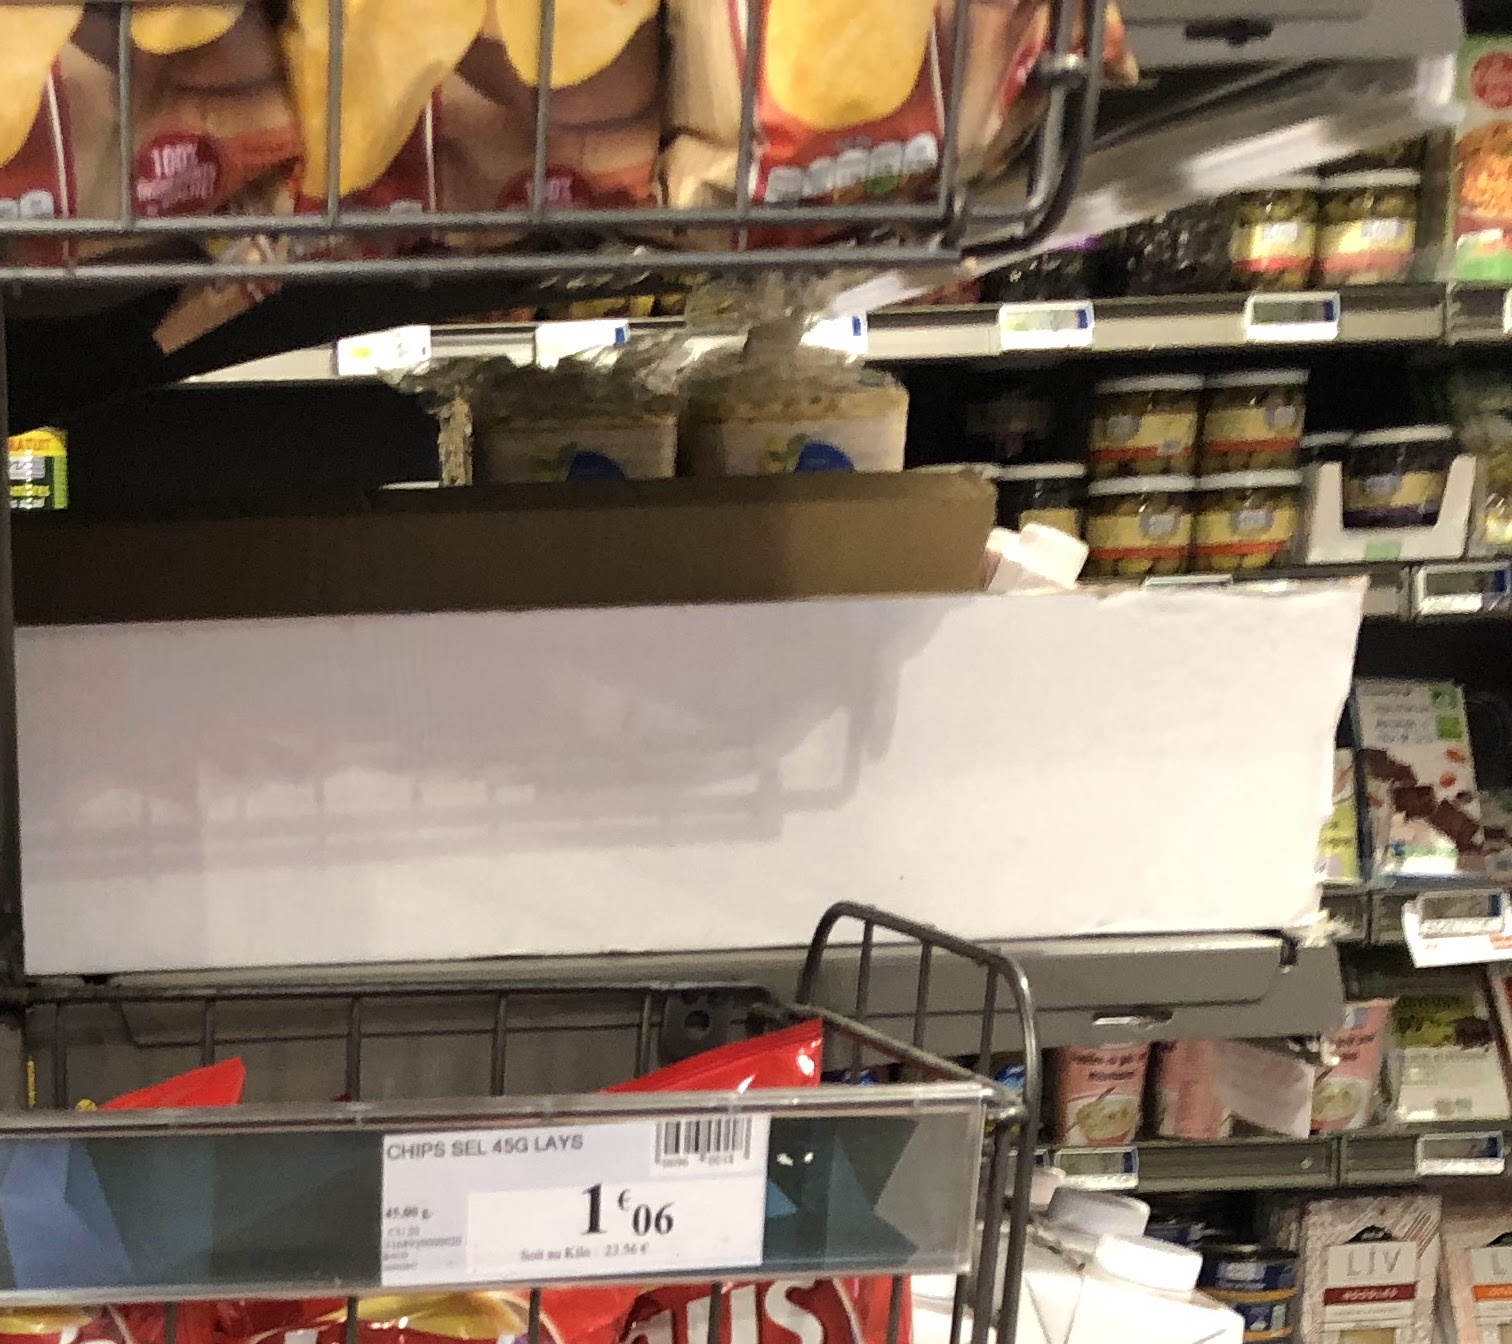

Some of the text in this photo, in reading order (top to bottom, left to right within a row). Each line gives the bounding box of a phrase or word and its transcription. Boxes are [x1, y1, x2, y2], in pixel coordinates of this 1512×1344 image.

[388, 1133, 583, 1160] CHIPS SEL 45G LAYS
